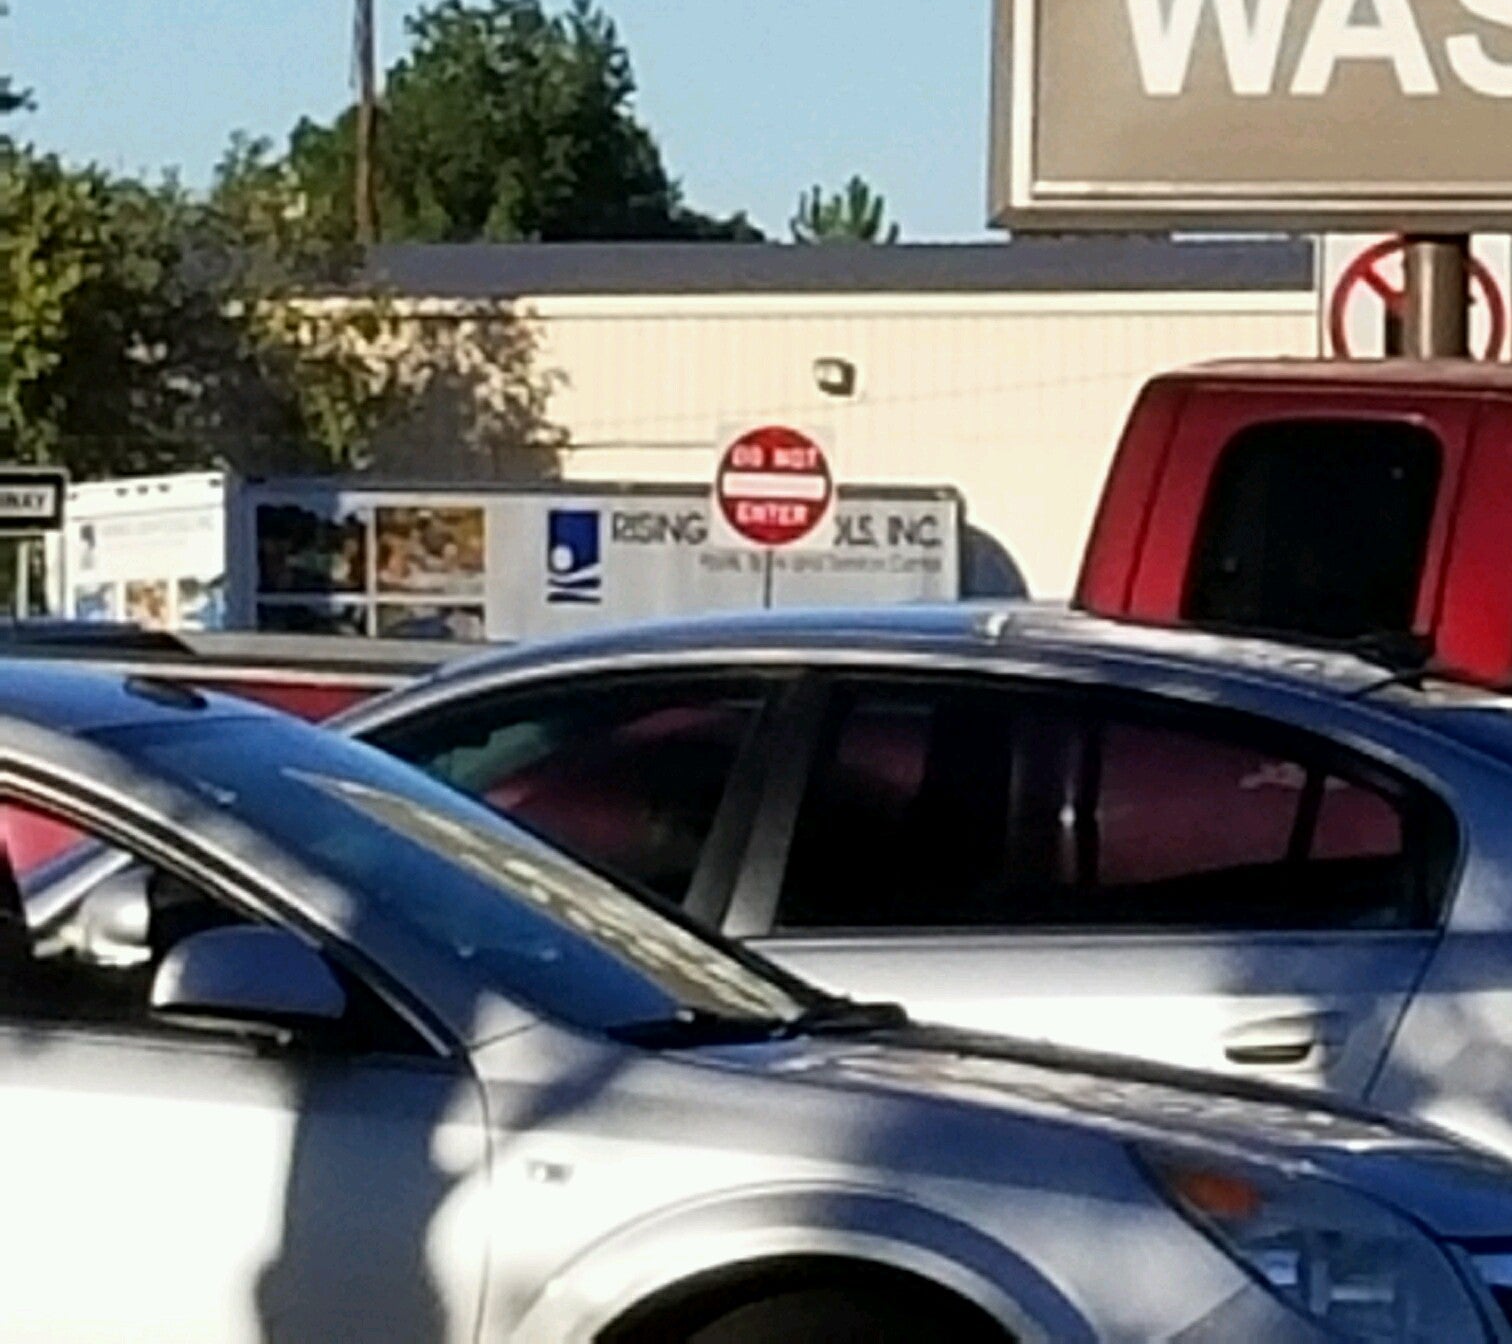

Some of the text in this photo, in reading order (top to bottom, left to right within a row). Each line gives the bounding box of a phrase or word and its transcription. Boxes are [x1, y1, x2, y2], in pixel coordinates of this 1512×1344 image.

[731, 444, 819, 469] DO NOT
[736, 500, 808, 527] ENTER
[611, 511, 708, 545] RISING
